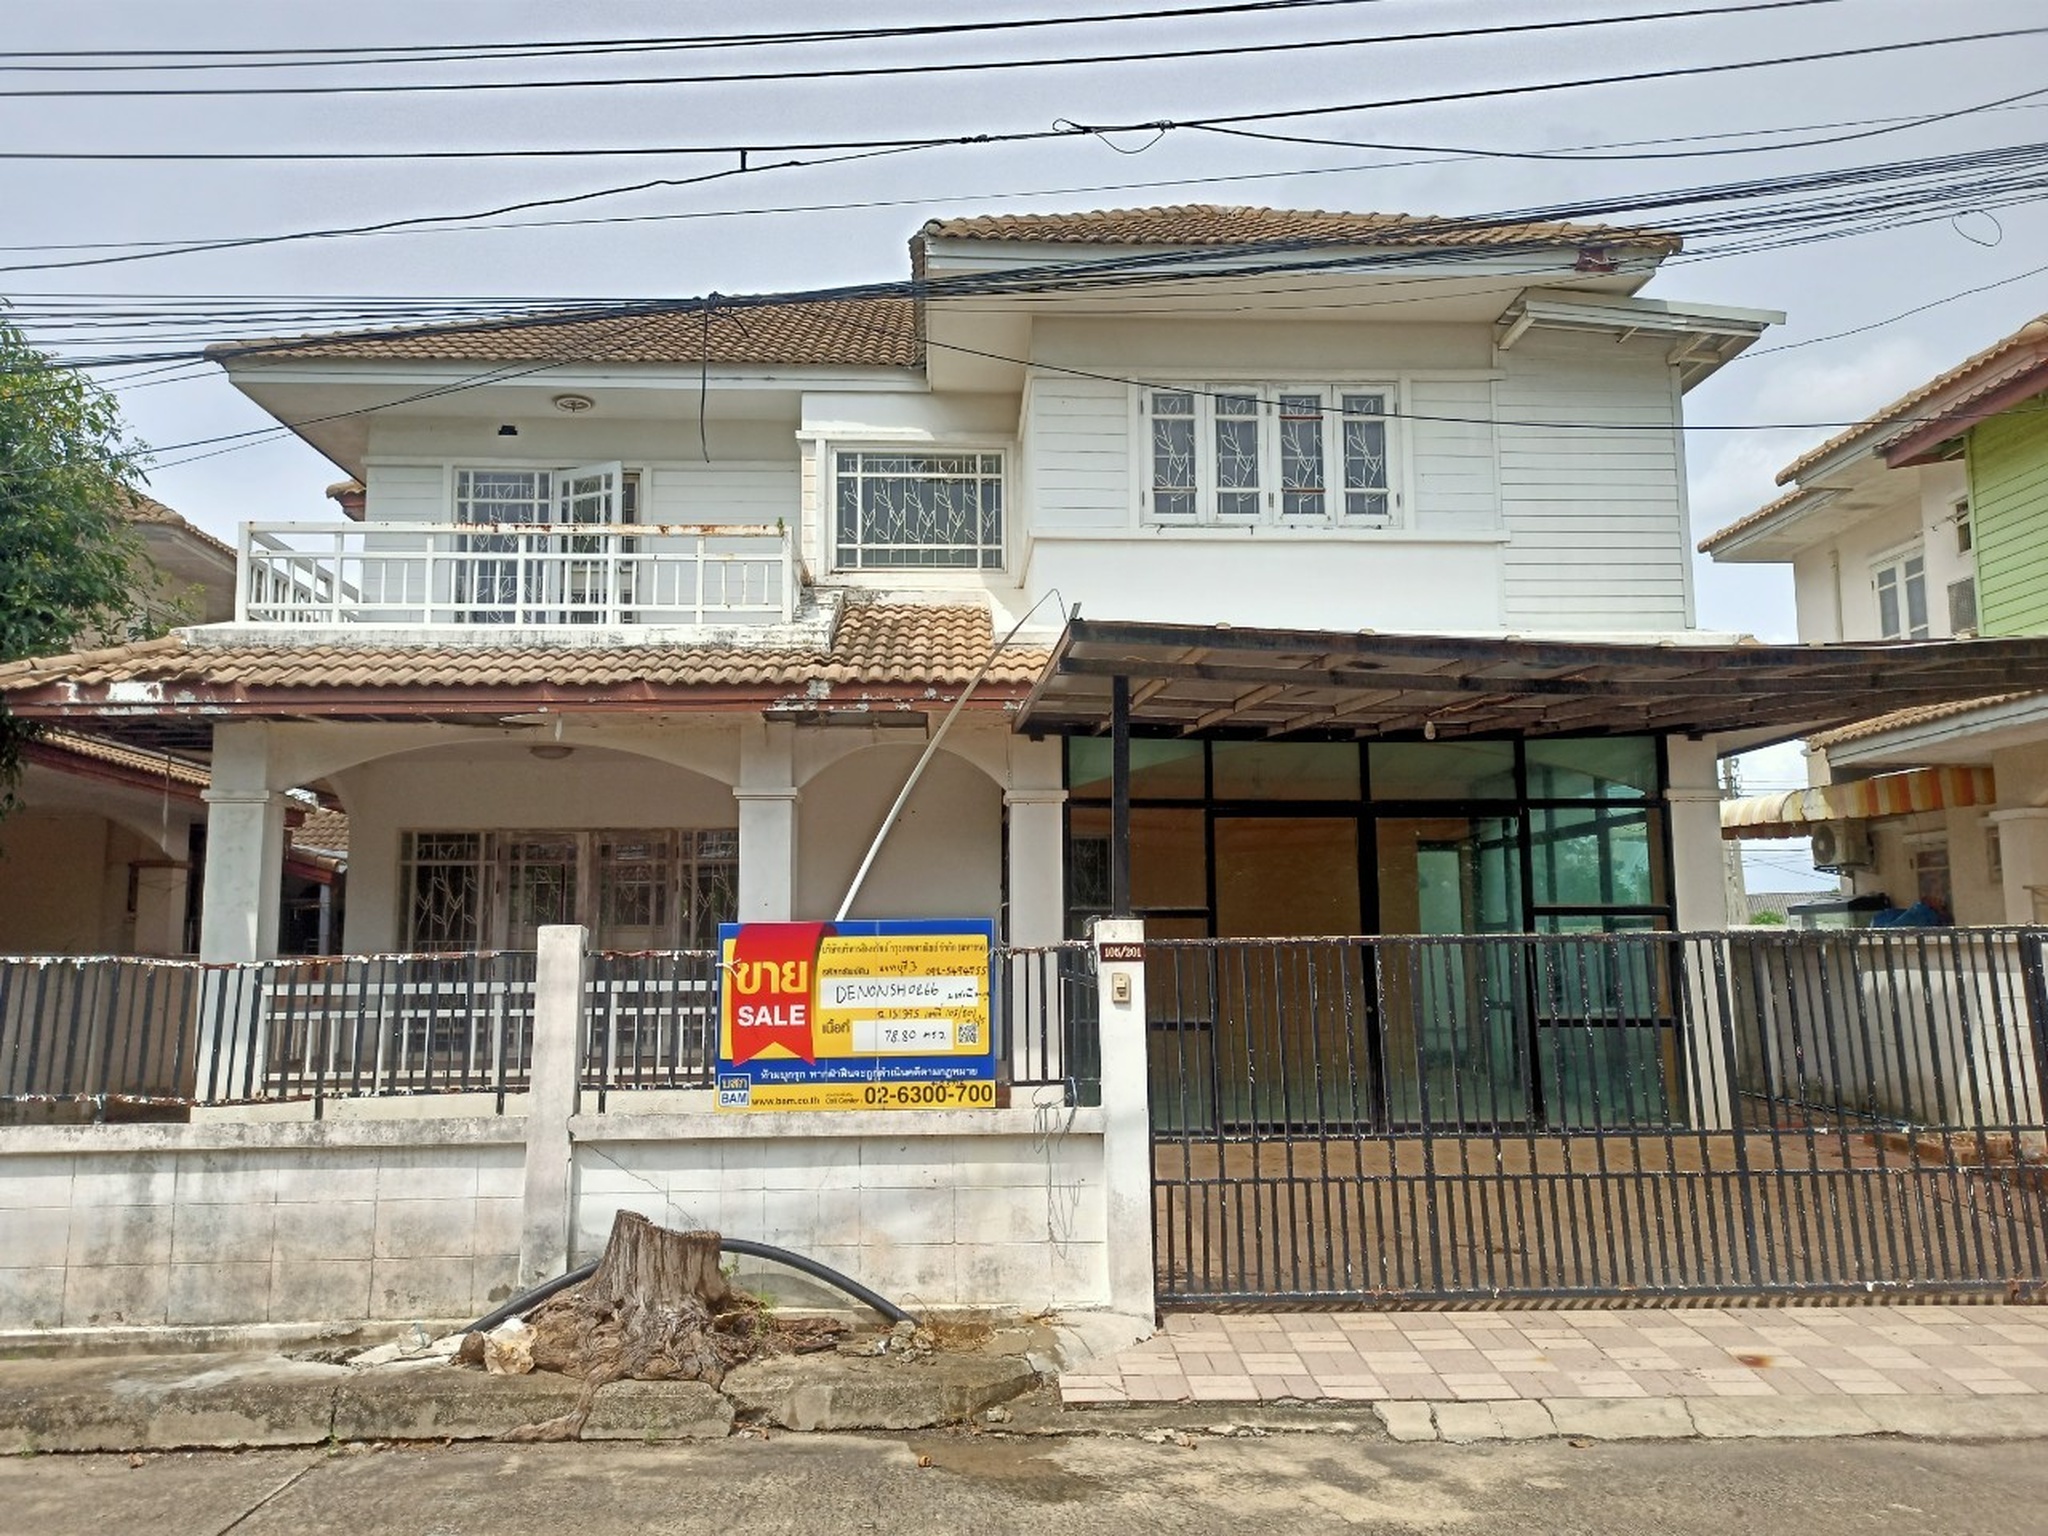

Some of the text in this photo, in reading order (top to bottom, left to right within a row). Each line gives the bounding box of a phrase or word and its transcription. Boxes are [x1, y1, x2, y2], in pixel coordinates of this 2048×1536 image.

[736, 960, 807, 994] ขาย
[737, 1004, 806, 1026] SALE
[822, 1019, 850, 1034] เนื้อที่
[761, 1069, 806, 1082] ห้ามบุกรุก
[721, 1092, 747, 1103] BAM
[752, 1097, 820, 1105] www.bam.co.th
[865, 1085, 993, 1104] 02-6300-700
